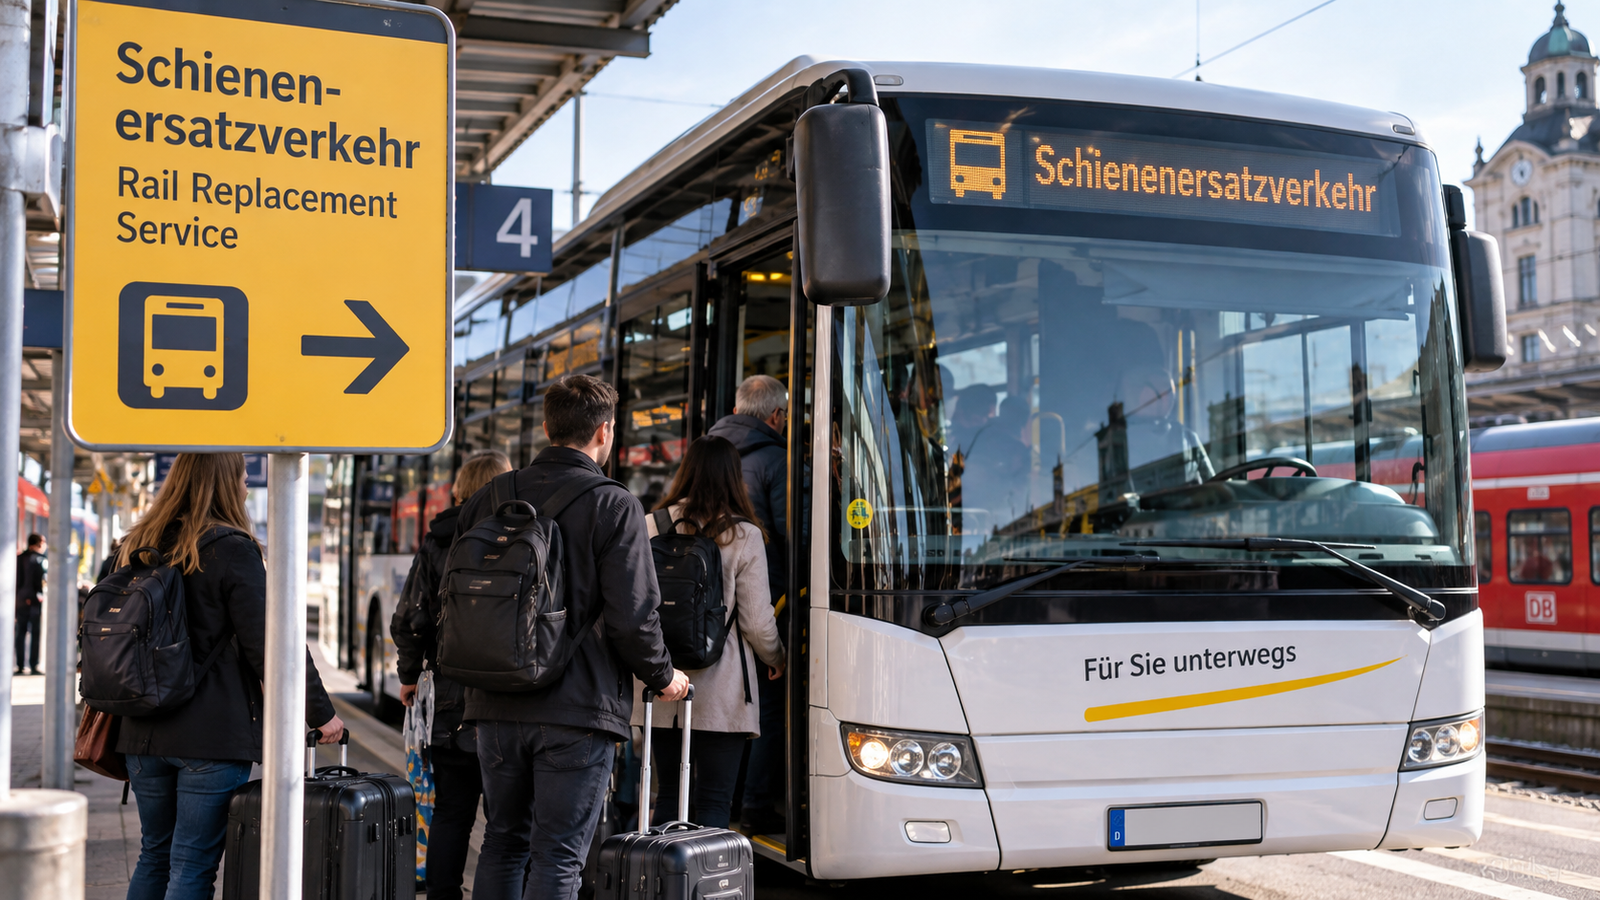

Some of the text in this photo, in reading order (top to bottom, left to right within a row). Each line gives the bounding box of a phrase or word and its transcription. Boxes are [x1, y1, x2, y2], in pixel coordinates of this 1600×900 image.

[116, 41, 341, 106] Schienen-
[115, 109, 421, 169] ersatzverkehr
[118, 166, 398, 219] Rail Replacement
[1035, 144, 1377, 213] Schienenersatzverkehr
[116, 211, 238, 249] Service
[496, 198, 538, 258] 4
[1529, 598, 1553, 618] DB
[1085, 645, 1297, 682] Für Sie unterwegs
[1114, 831, 1121, 841] D
